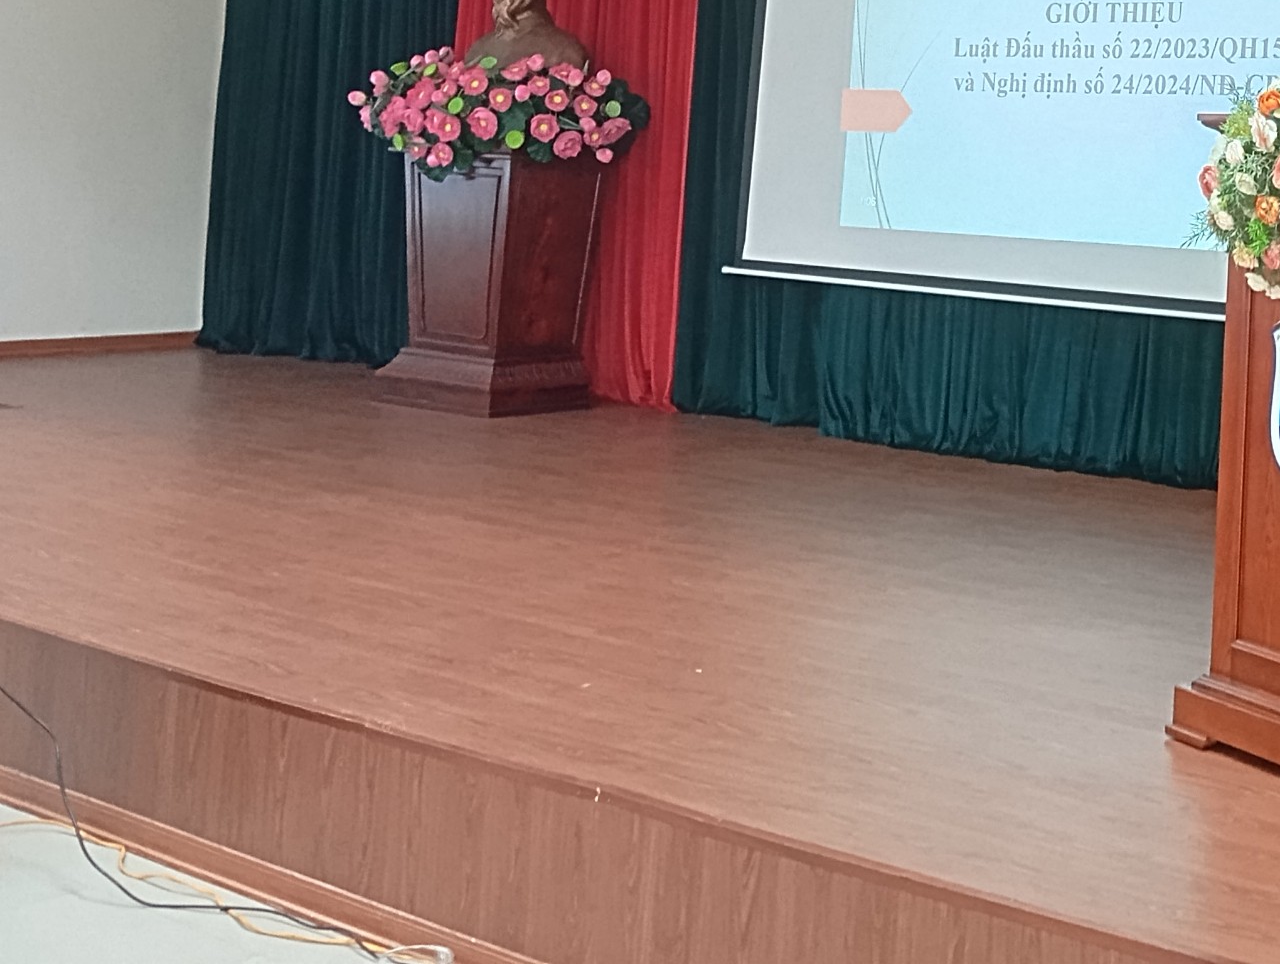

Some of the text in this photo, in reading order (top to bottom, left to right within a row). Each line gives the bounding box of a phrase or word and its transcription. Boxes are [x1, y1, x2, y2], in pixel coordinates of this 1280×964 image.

[953, 36, 1000, 64] Luật
[1005, 31, 1044, 59] Đấu
[1051, 31, 1095, 59] thầu
[1102, 30, 1123, 59] số
[953, 71, 975, 92] và
[981, 72, 1028, 99] Nghị
[1033, 72, 1077, 100] định
[1084, 66, 1105, 95] số
